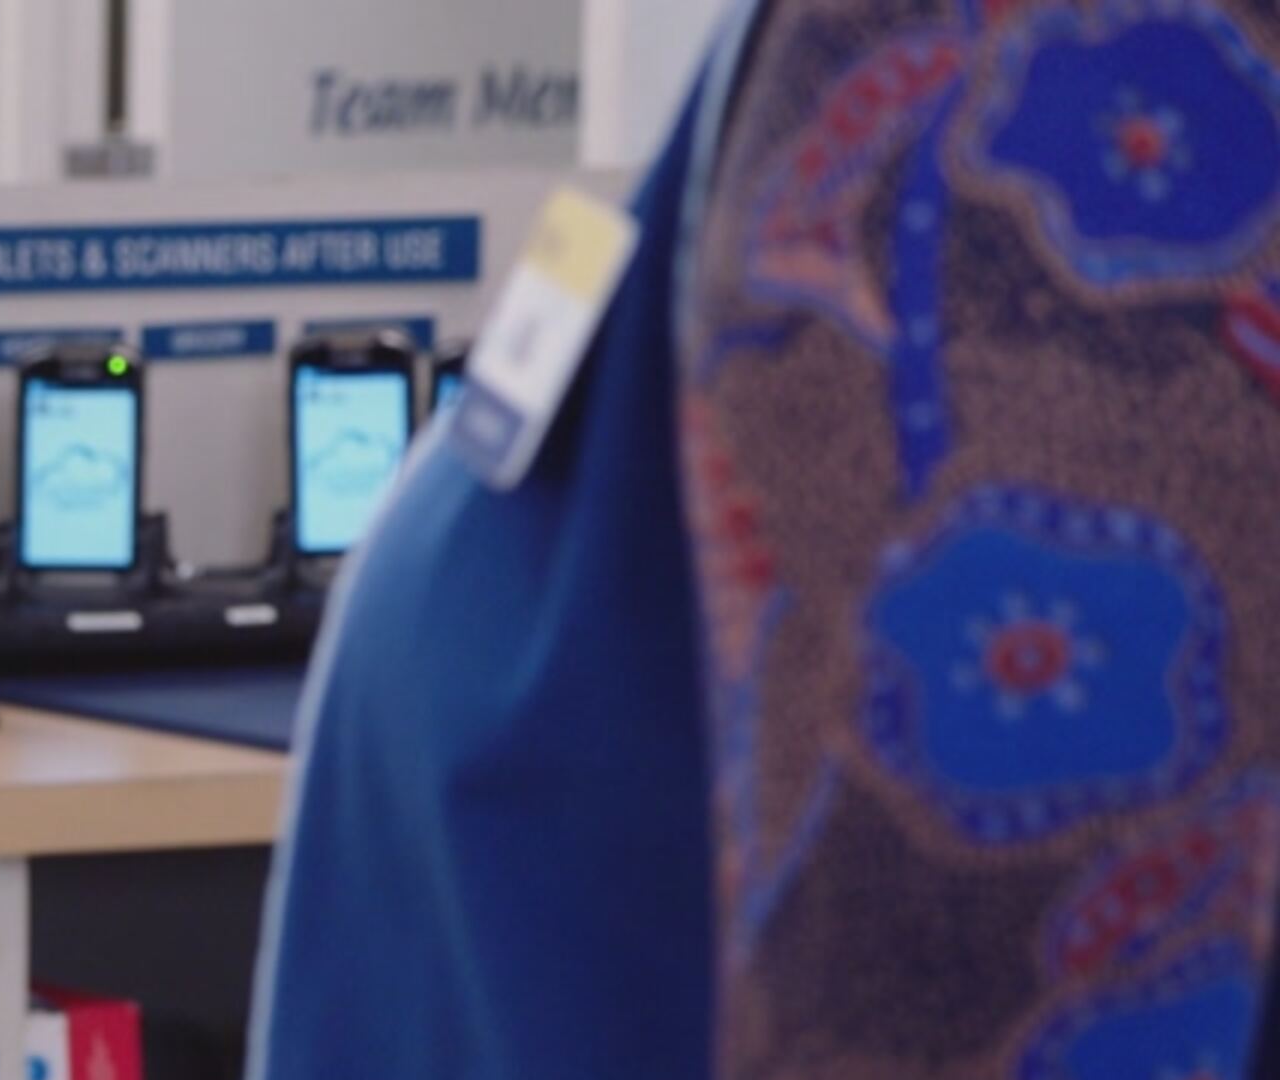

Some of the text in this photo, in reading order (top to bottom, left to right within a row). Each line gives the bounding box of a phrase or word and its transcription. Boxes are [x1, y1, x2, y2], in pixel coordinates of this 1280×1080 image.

[308, 66, 456, 133] Team
[82, 240, 108, 279] &
[113, 235, 278, 277] SCANNERS
[281, 229, 377, 271] AFTER
[383, 226, 446, 271] USE
